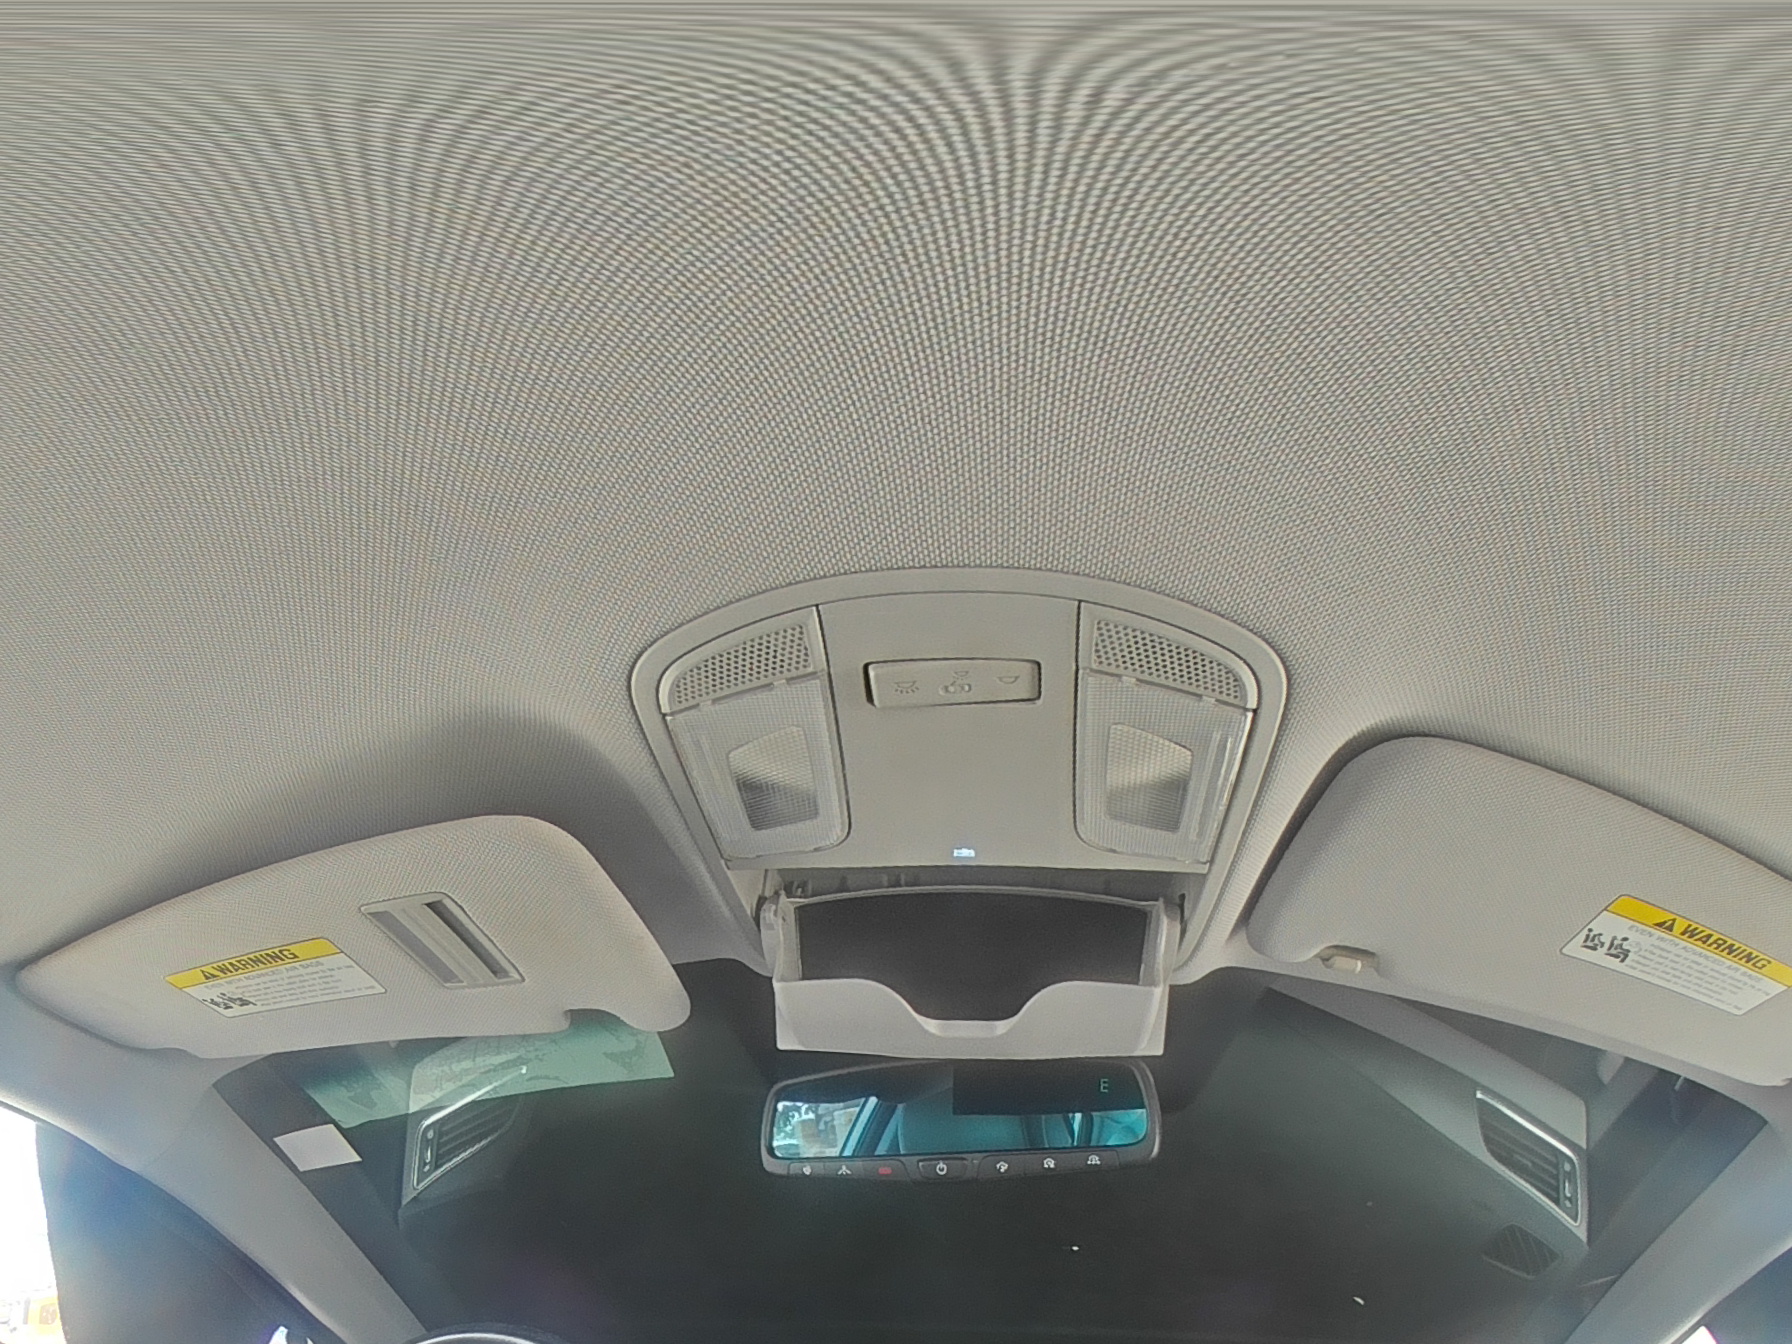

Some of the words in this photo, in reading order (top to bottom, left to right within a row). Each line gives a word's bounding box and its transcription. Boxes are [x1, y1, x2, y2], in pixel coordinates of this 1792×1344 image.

[1655, 933, 1680, 948] WITH
[1679, 923, 1772, 970] WARNING
[212, 949, 300, 976] WARNING
[1100, 1078, 1109, 1093] E
